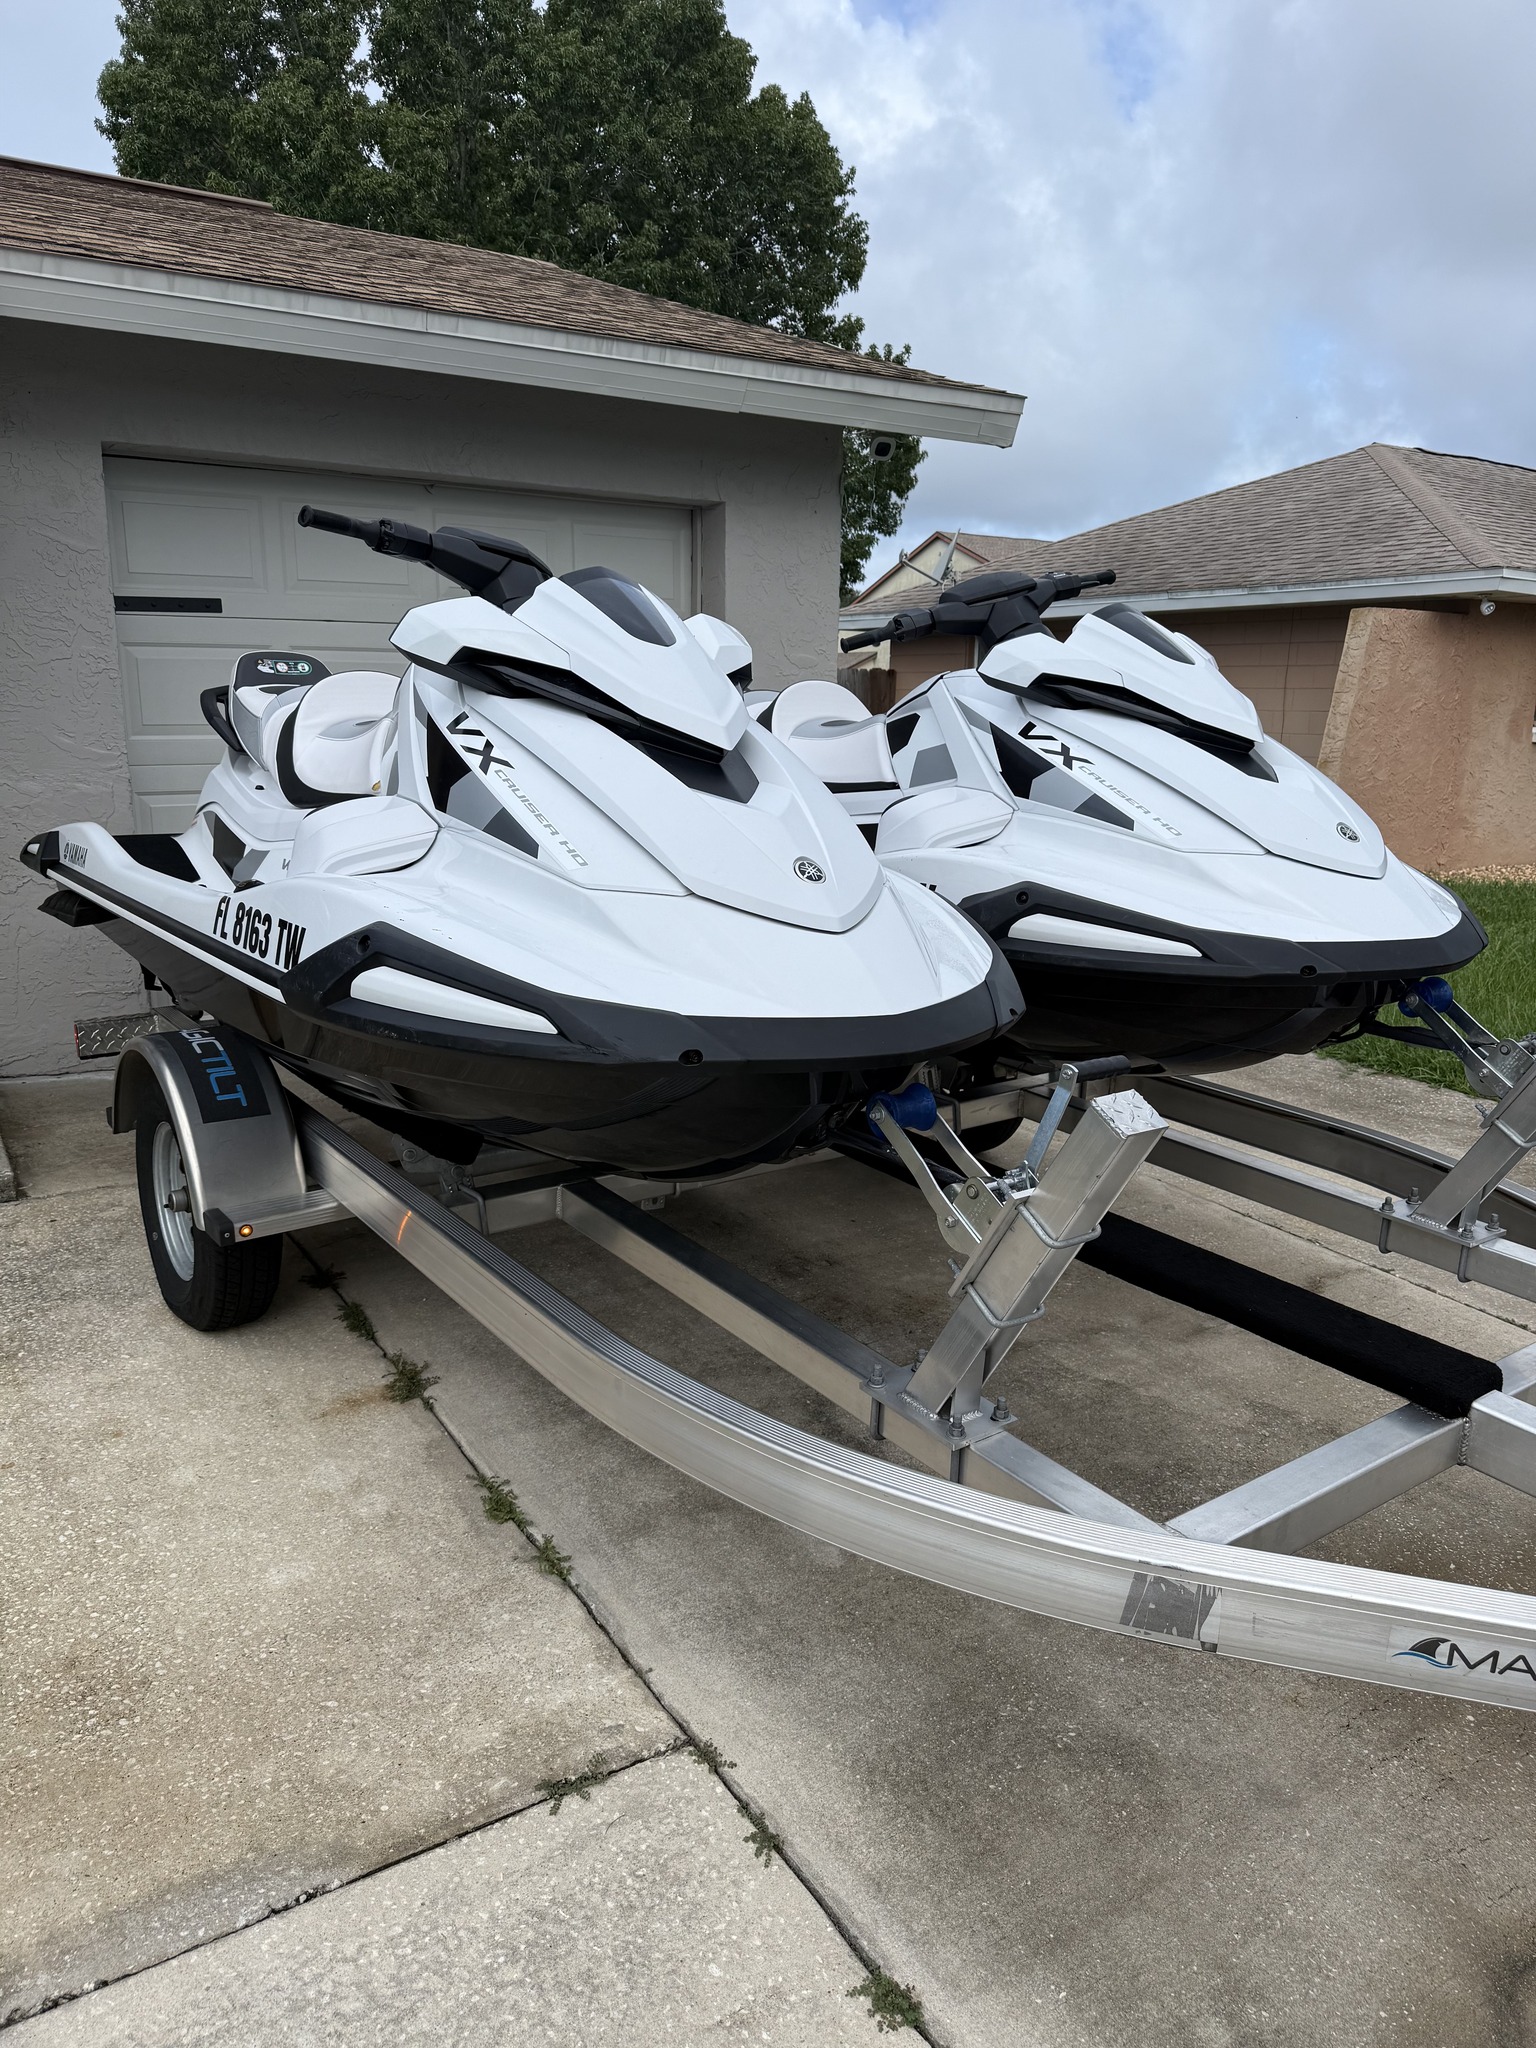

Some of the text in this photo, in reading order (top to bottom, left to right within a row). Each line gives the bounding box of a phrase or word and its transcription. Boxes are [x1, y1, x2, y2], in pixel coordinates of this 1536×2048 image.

[446, 711, 515, 775] VX
[494, 769, 559, 836] CRUISER
[1018, 721, 1095, 771] VX
[1078, 765, 1151, 815] CRUISER
[213, 895, 307, 970] FL 8163 TW
[1446, 1643, 1536, 1681] MA
